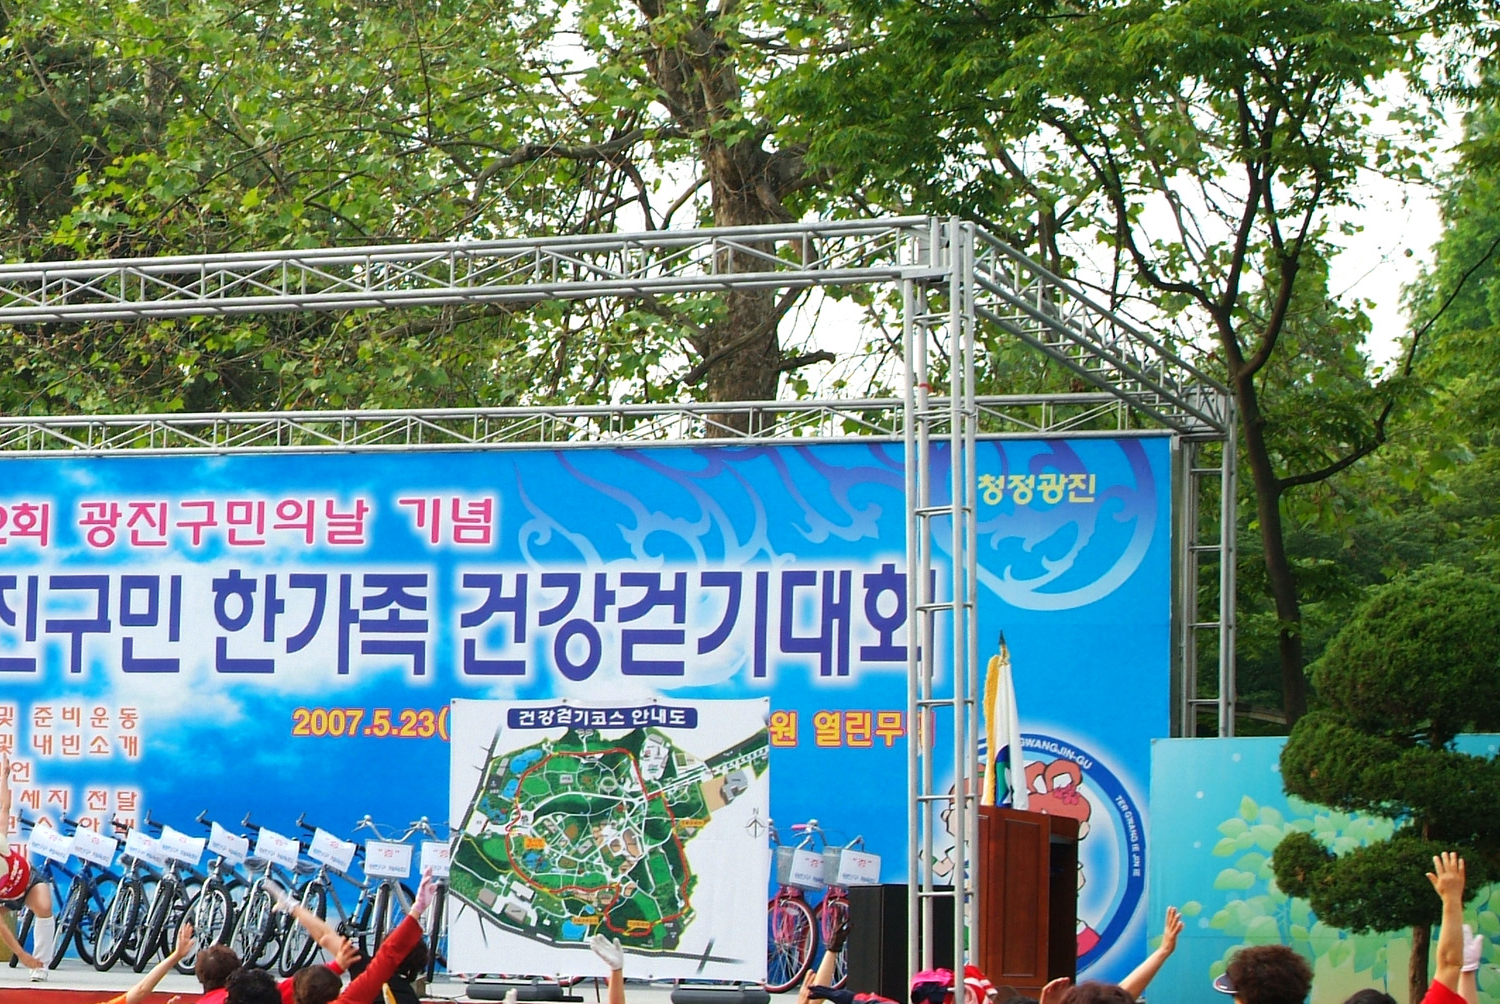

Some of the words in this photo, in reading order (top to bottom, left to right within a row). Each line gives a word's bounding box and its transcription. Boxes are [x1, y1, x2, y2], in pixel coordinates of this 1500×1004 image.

[977, 473, 1096, 506] 청정광진
[79, 500, 368, 548] 광진구민의날
[399, 498, 492, 544] 기념
[212, 568, 428, 675] 한가족
[460, 563, 936, 682] 건강걷기대회
[33, 706, 139, 729] 준비운동
[292, 705, 450, 742] 2007.5.23(
[518, 708, 626, 727] 건강걷기코스
[631, 708, 687, 726] 안내도
[33, 735, 138, 758] 내빈소개
[87, 790, 138, 812] 전달
